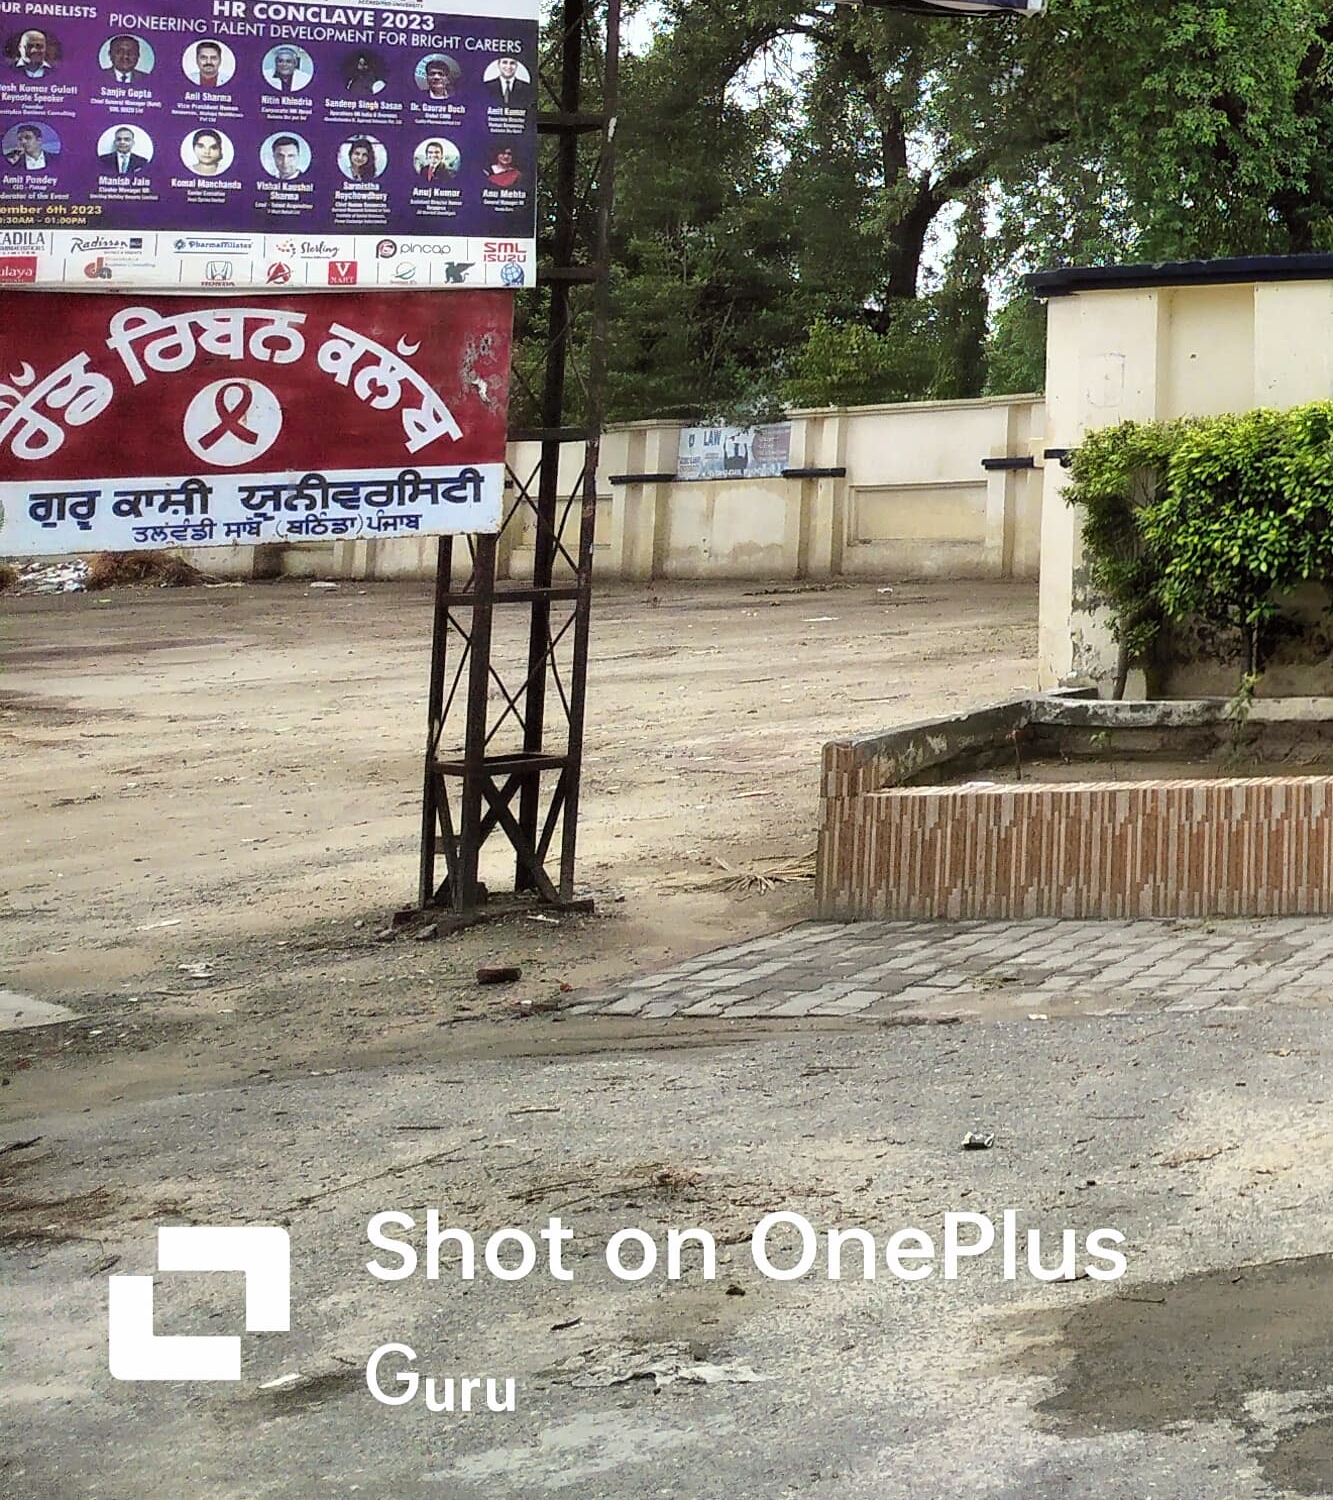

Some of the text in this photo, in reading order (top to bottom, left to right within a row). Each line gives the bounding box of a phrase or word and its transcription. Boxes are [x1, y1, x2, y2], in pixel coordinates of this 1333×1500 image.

[25, 3, 97, 19] PANELISTS
[213, 0, 435, 31] HR CONCLAVE 2023
[109, 13, 522, 53] PIONEERING TALENT DEVELOPMENT FOR BRIGHT CAREERS
[128, 88, 152, 99] Gupta
[202, 92, 232, 103] Sharma
[26, 176, 58, 187] Pandey
[171, 178, 242, 190] Komal Manchanda
[46, 204, 102, 216] 6th 2023
[71, 237, 129, 253] Radisson
[483, 242, 527, 254] SML
[483, 254, 527, 263] ISUZU
[337, 261, 350, 276] V
[106, 307, 308, 387] ਰਿਬਨ
[112, 478, 213, 518] ਕਾਸ਼ੀ
